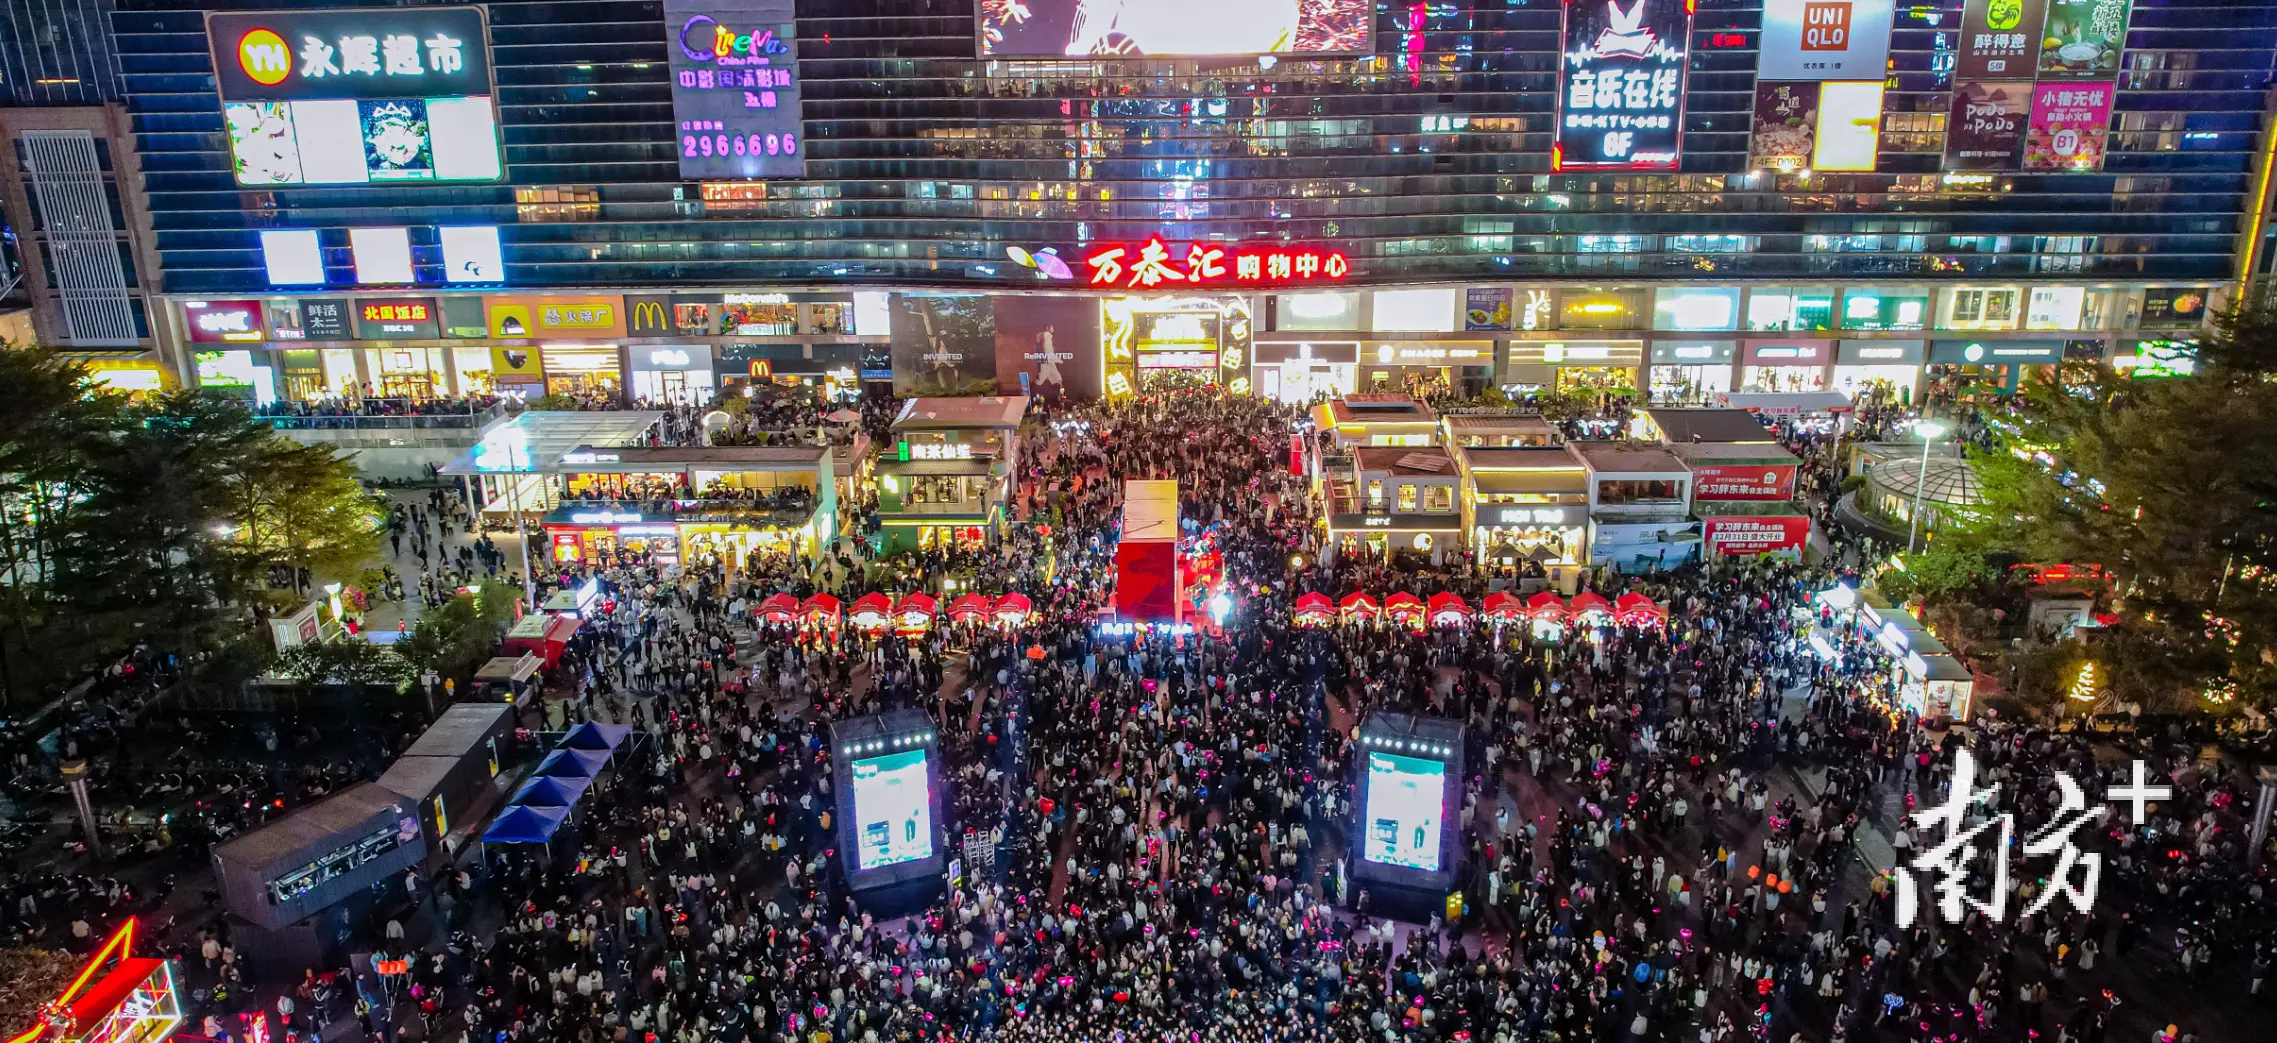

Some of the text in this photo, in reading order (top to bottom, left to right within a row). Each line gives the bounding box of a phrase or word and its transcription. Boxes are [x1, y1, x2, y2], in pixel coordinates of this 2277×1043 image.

[1809, 8, 1843, 24] UNI
[1807, 28, 1844, 47] QLO
[1973, 33, 2026, 49] 醉得意
[300, 33, 462, 77] 永辉超市
[718, 57, 769, 65] China Film
[679, 69, 792, 88] 中影国际影城
[1570, 69, 1677, 108] 音乐在线
[683, 133, 796, 157] 2966696
[2056, 135, 2075, 148] B1
[1088, 238, 1347, 287] 万泰汇 购物中心
[308, 304, 337, 317] 鲜活
[364, 305, 427, 321] 北国饭店
[310, 317, 339, 328] 太二
